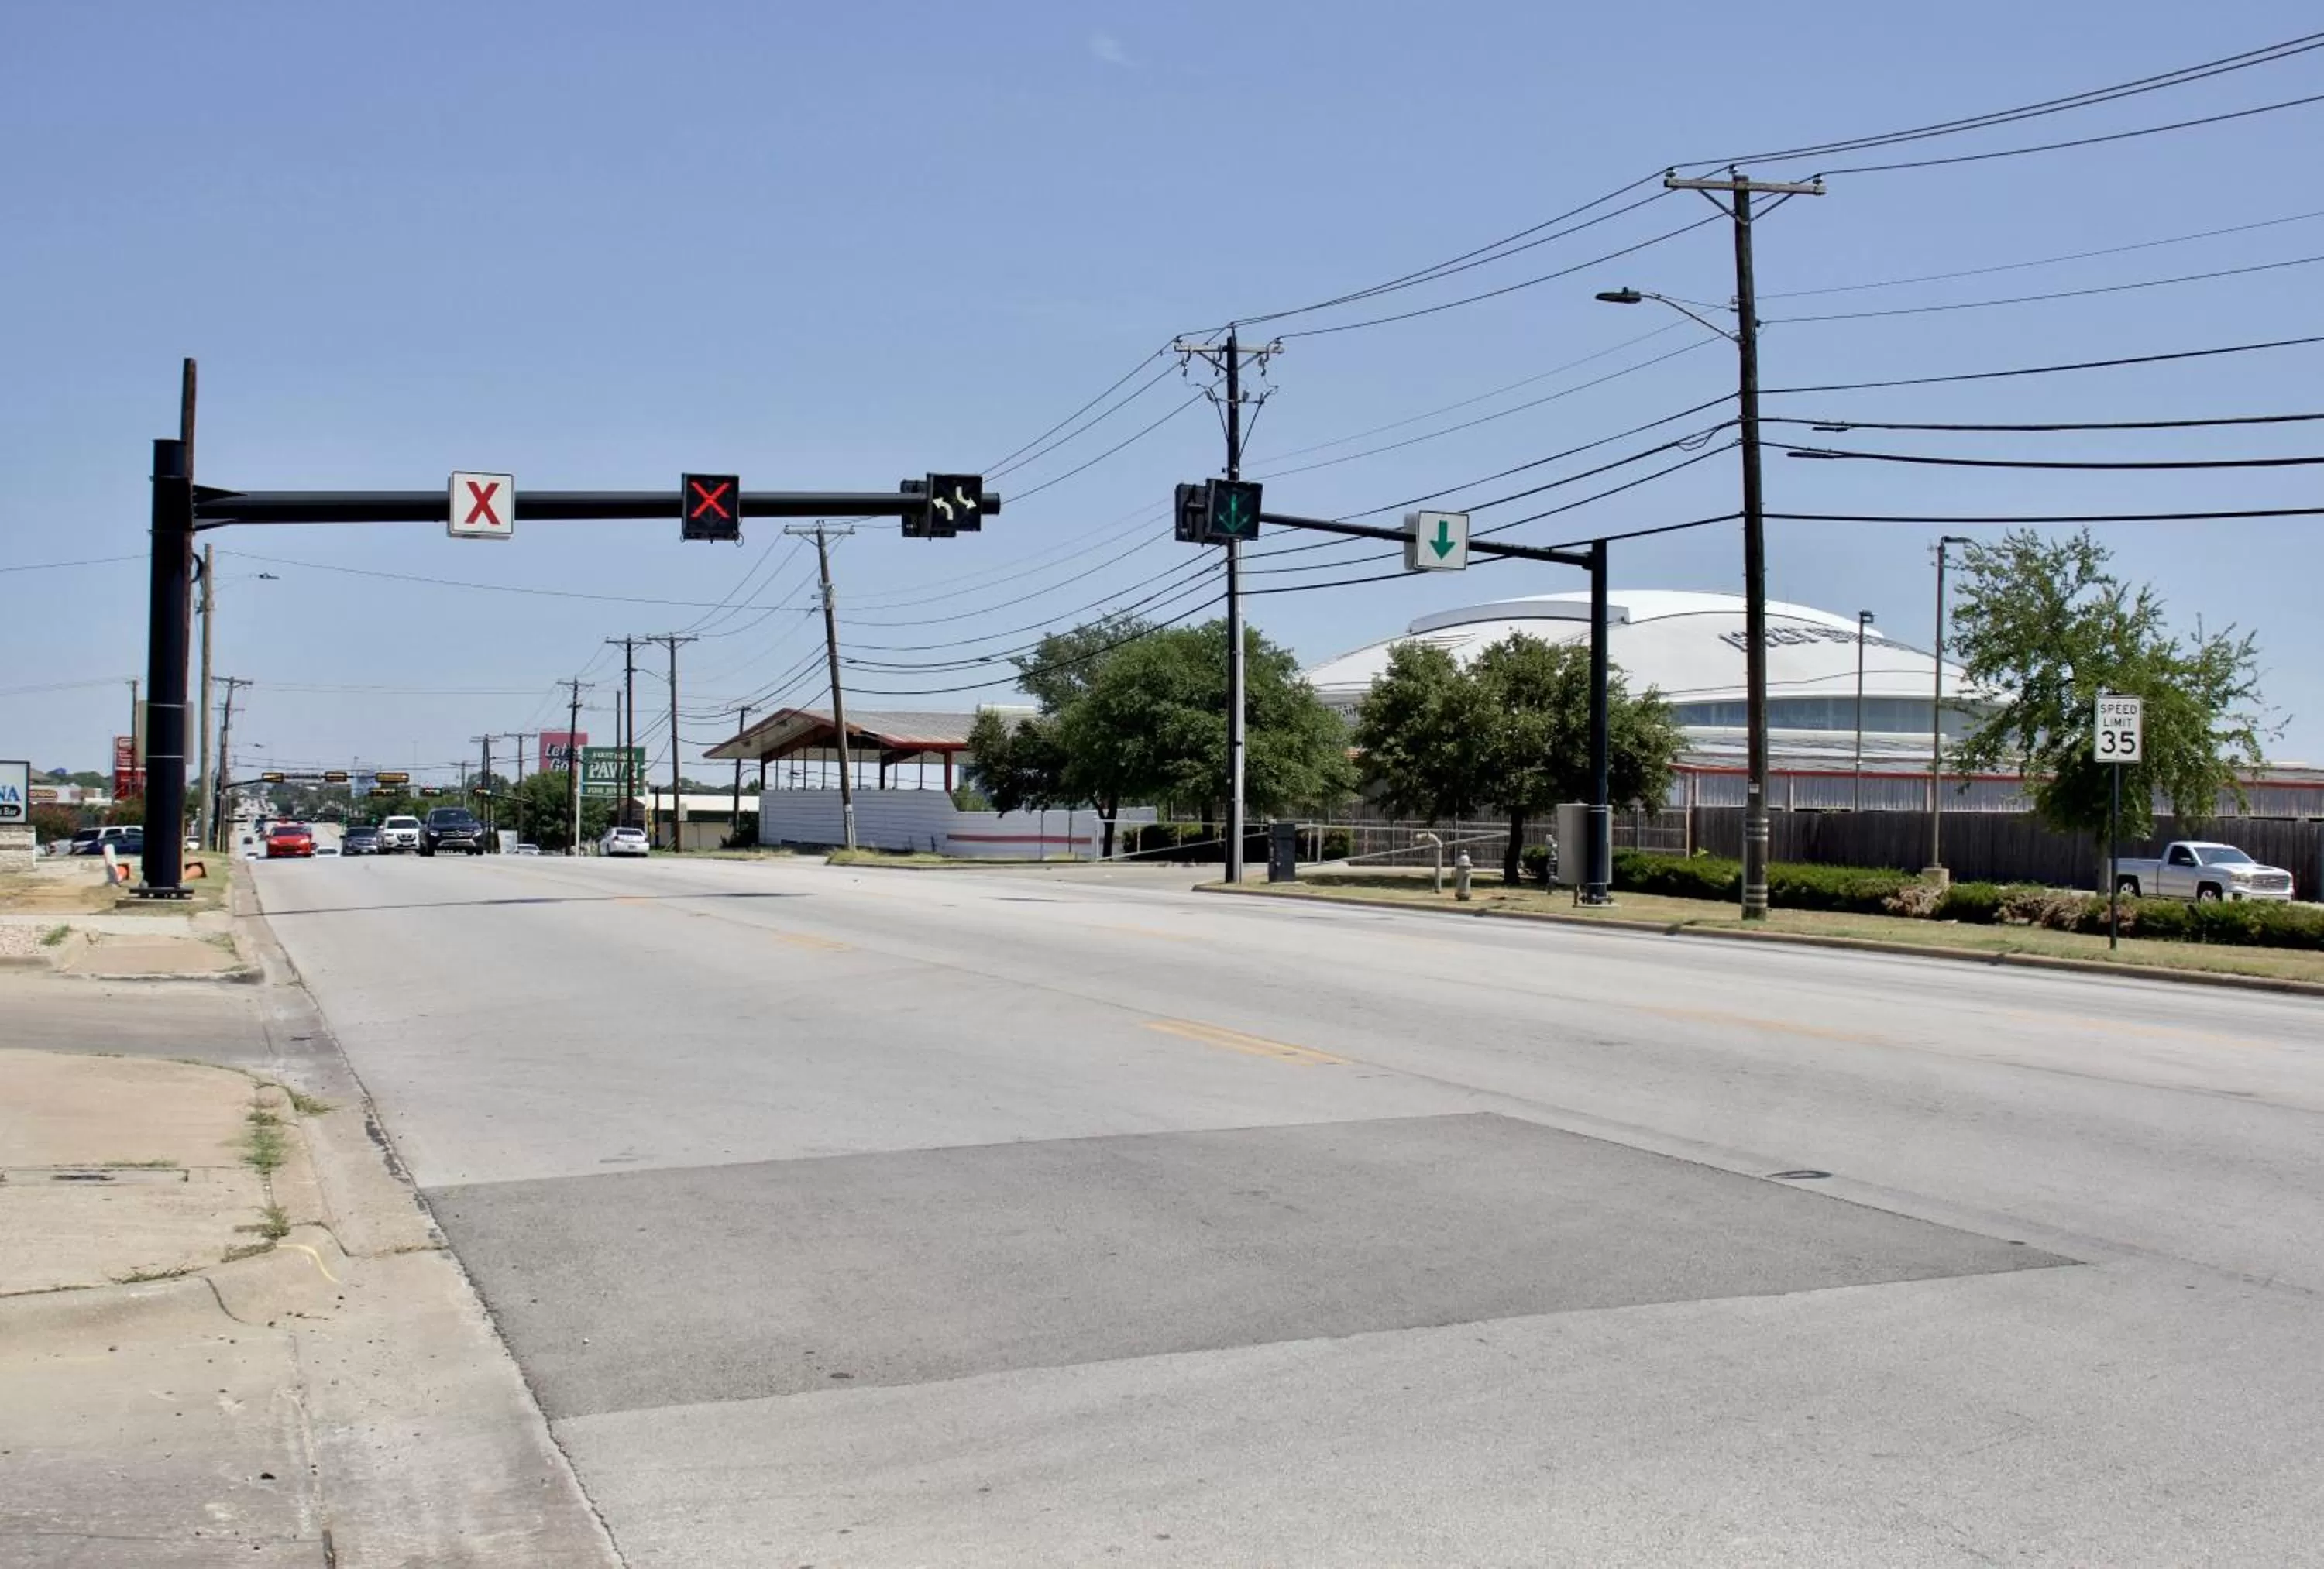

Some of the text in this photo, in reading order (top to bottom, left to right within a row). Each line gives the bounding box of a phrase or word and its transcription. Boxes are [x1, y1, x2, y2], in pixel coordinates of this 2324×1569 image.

[2100, 704, 2137, 714] SPEED
[2103, 718, 2132, 727] LIMIT
[2101, 730, 2136, 754] 35
